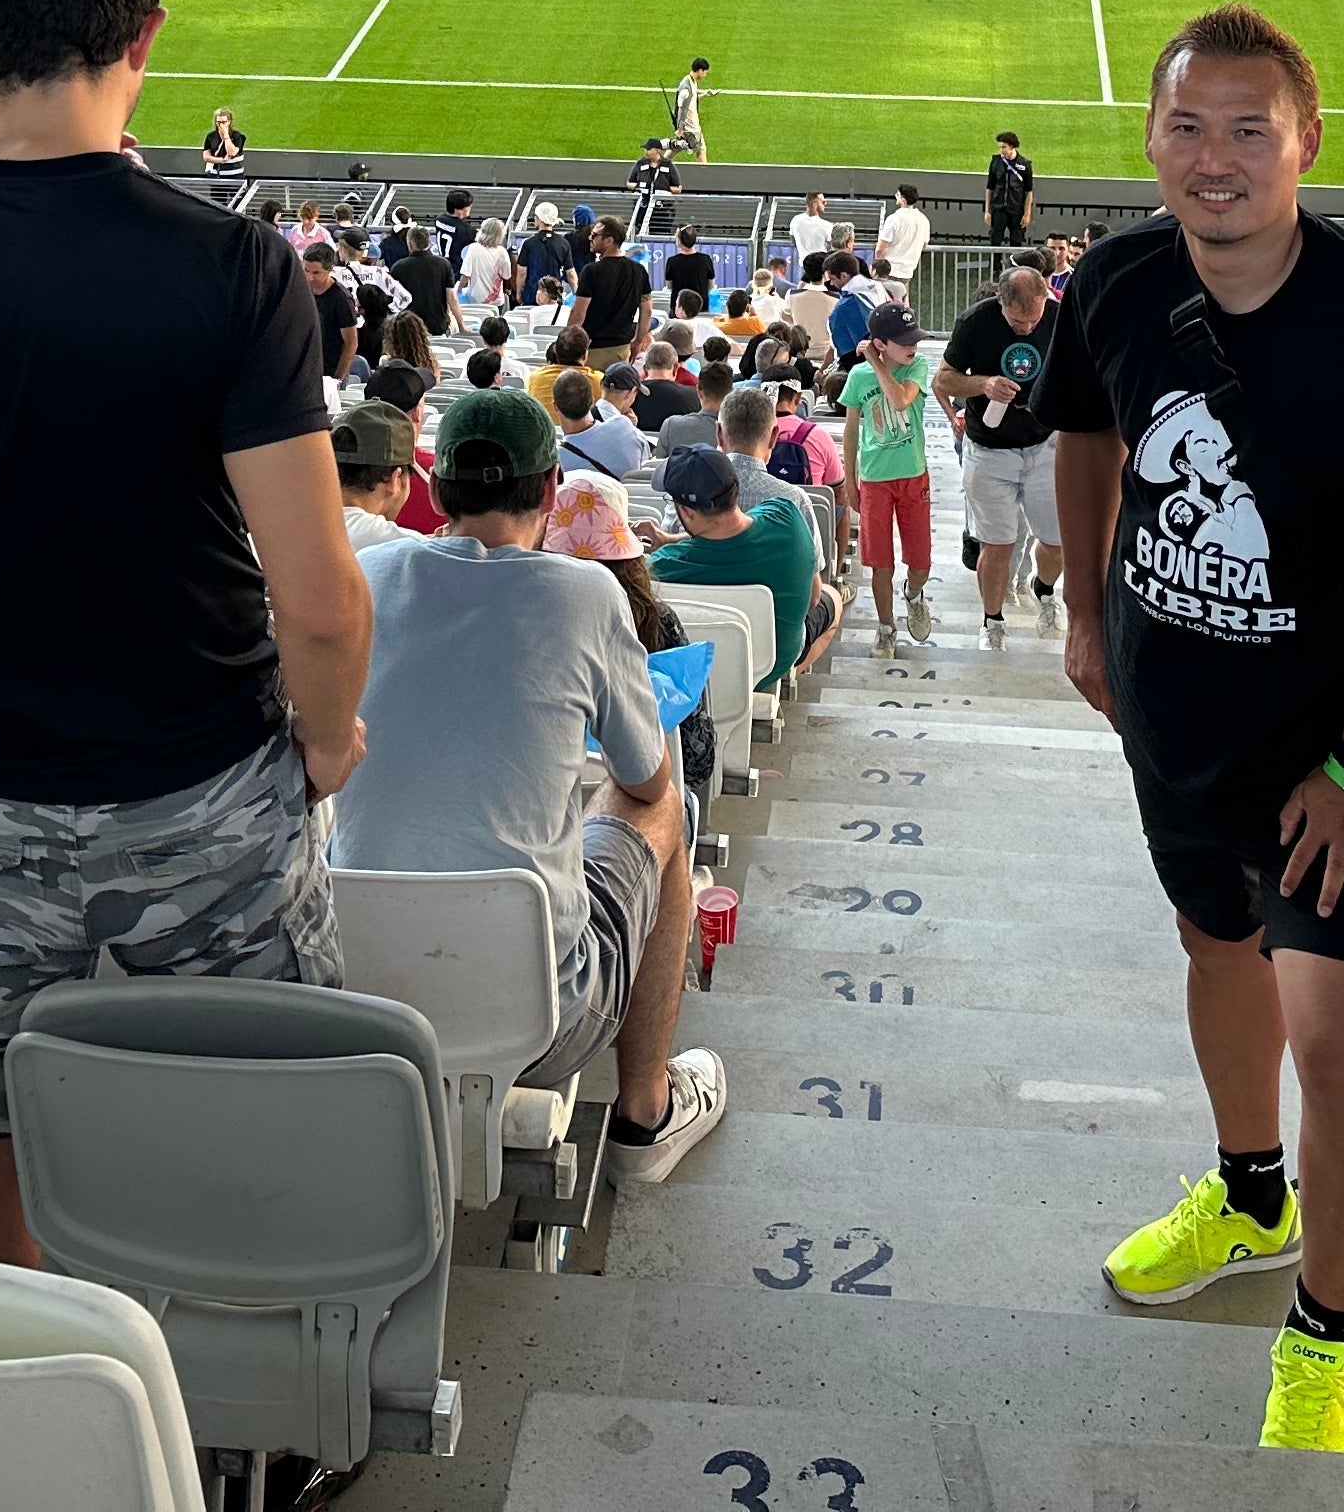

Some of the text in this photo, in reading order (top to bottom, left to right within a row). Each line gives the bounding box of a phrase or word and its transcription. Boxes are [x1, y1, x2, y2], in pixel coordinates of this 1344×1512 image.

[1123, 559, 1296, 632] LIBRE
[1136, 525, 1273, 603] BONÉRA
[1186, 621, 1210, 635] LOS
[1214, 629, 1273, 644] PUNTOS
[794, 1076, 883, 1121] 31
[753, 1221, 894, 1296] 32
